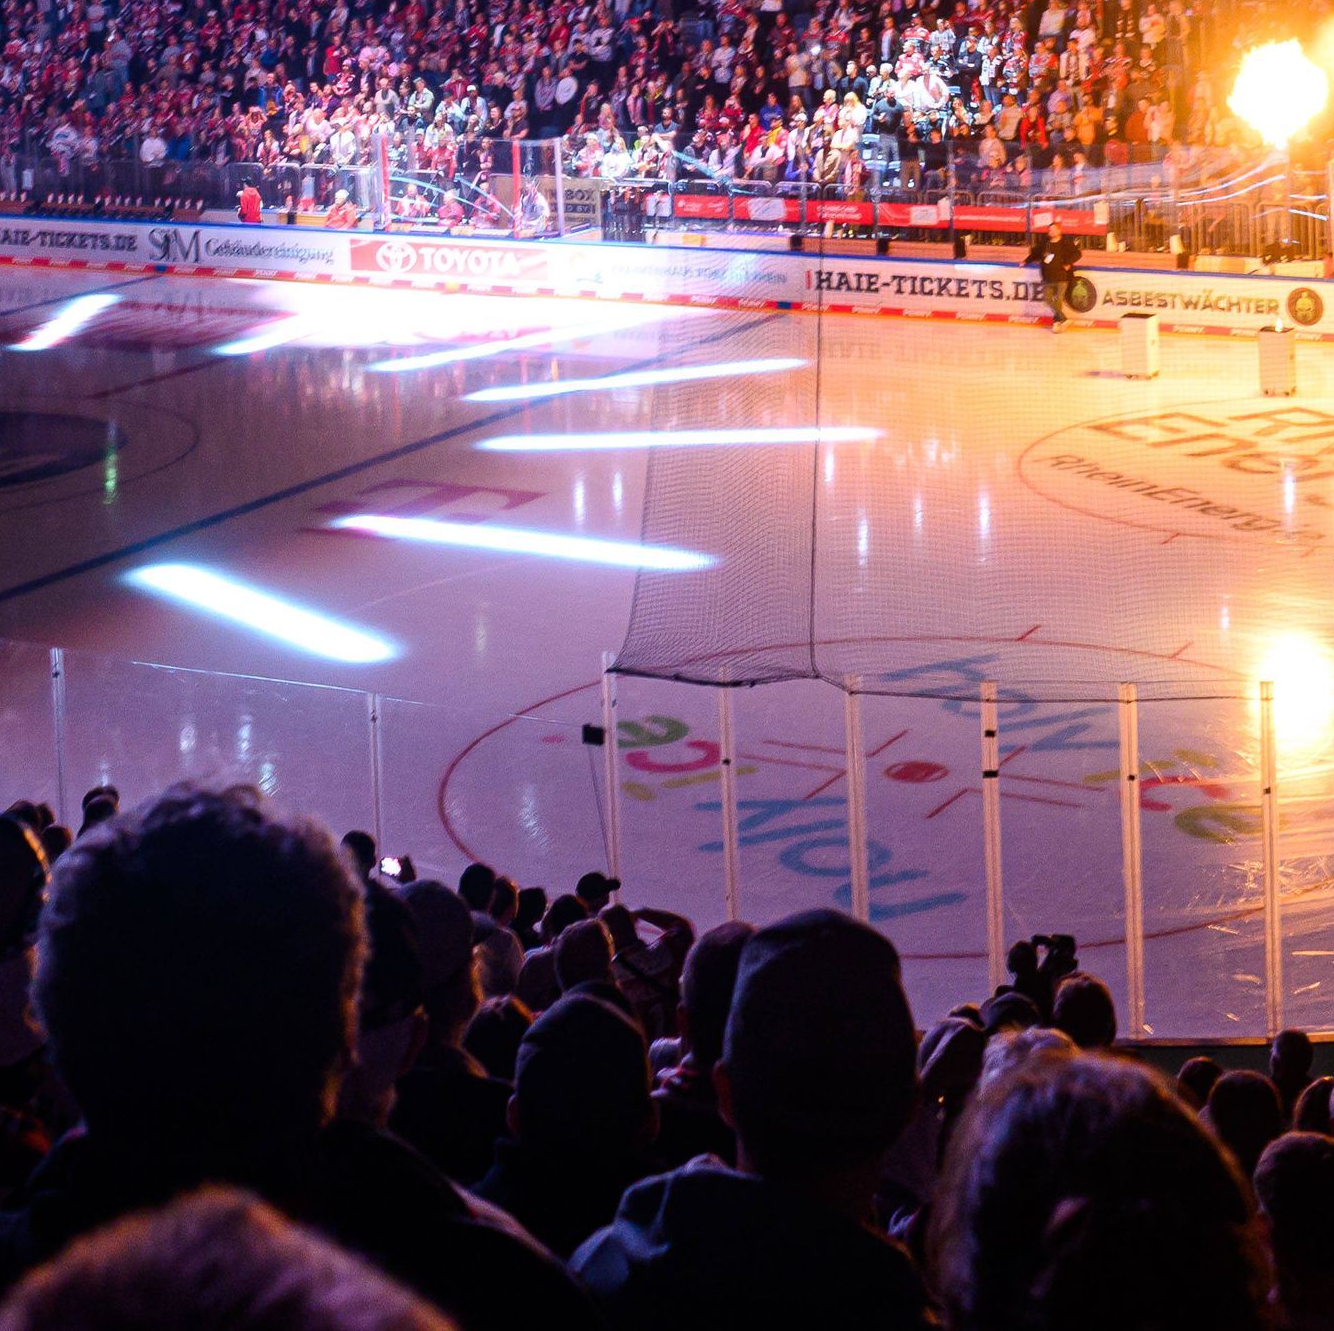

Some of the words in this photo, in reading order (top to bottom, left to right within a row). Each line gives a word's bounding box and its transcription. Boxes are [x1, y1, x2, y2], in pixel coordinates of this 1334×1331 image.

[418, 246, 522, 280] TOYOTA
[815, 268, 1046, 303] HAIE-TICKETS.DE
[1101, 288, 1281, 316] ASBESTWÄCHTER
